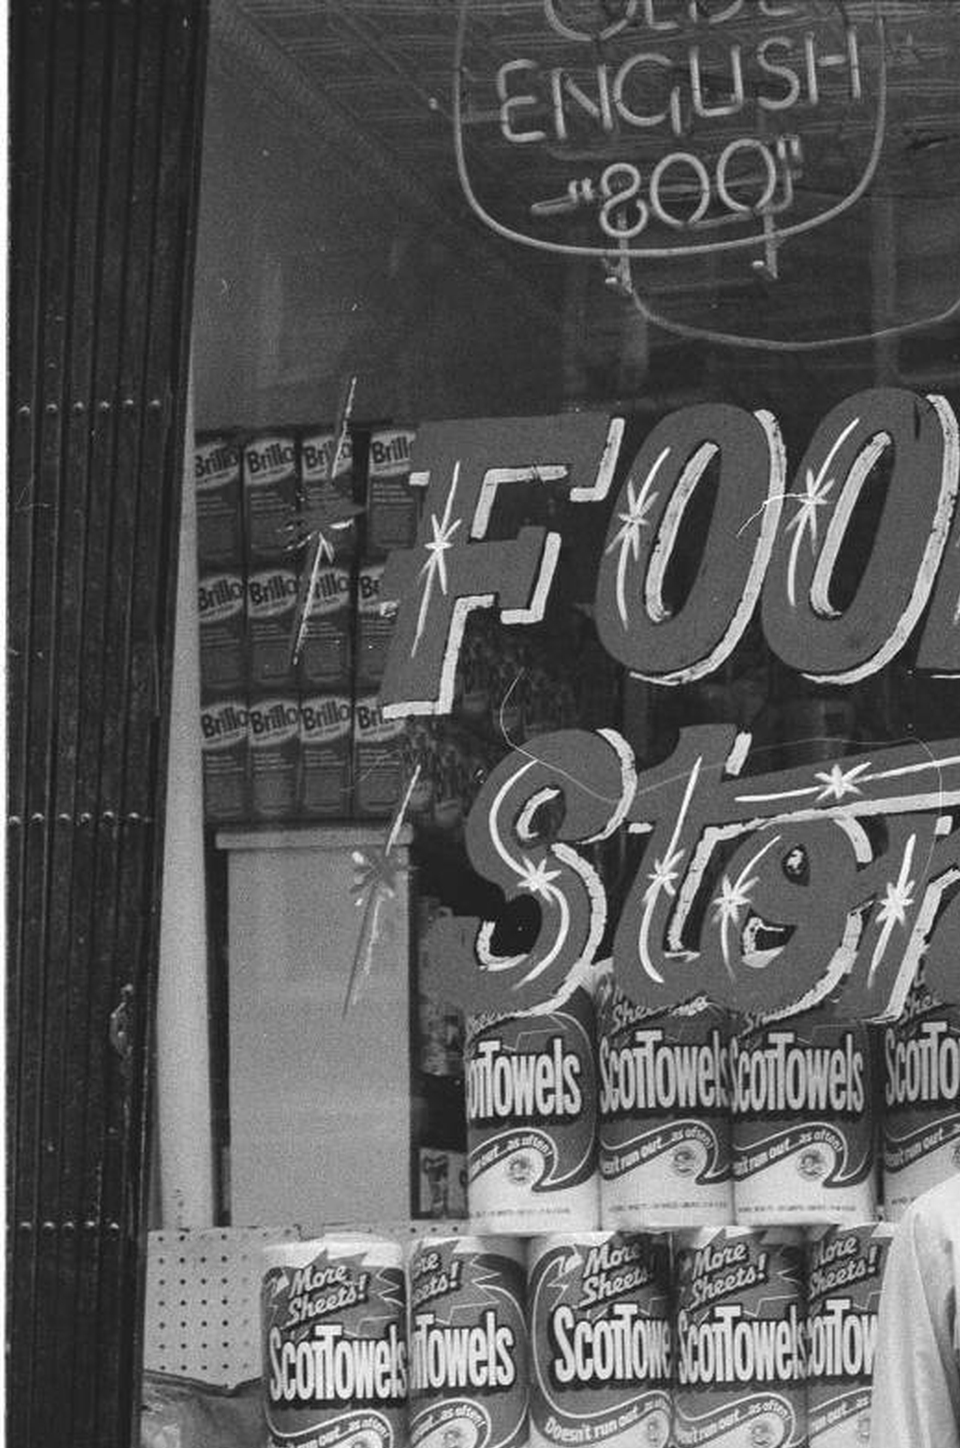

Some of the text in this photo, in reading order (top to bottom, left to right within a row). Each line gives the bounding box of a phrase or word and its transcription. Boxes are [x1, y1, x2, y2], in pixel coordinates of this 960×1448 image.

[500, 28, 861, 142] ENGLISH
[249, 443, 295, 473] Brillo
[372, 436, 413, 465] Brill
[250, 575, 298, 605] Brillo
[315, 573, 349, 602] rillo
[201, 706, 247, 738] Brillo
[250, 703, 298, 734] Brillo
[302, 700, 350, 731] Brillo
[692, 1244, 747, 1281] More
[289, 1265, 347, 1299] More
[687, 1253, 766, 1312] Sheets!
[284, 1273, 368, 1328] Sheets!
[411, 1311, 515, 1390] tTowels
[554, 1304, 671, 1383] ScotTowe
[269, 1324, 407, 1401] ScotTowels
[594, 1419, 618, 1439] run
